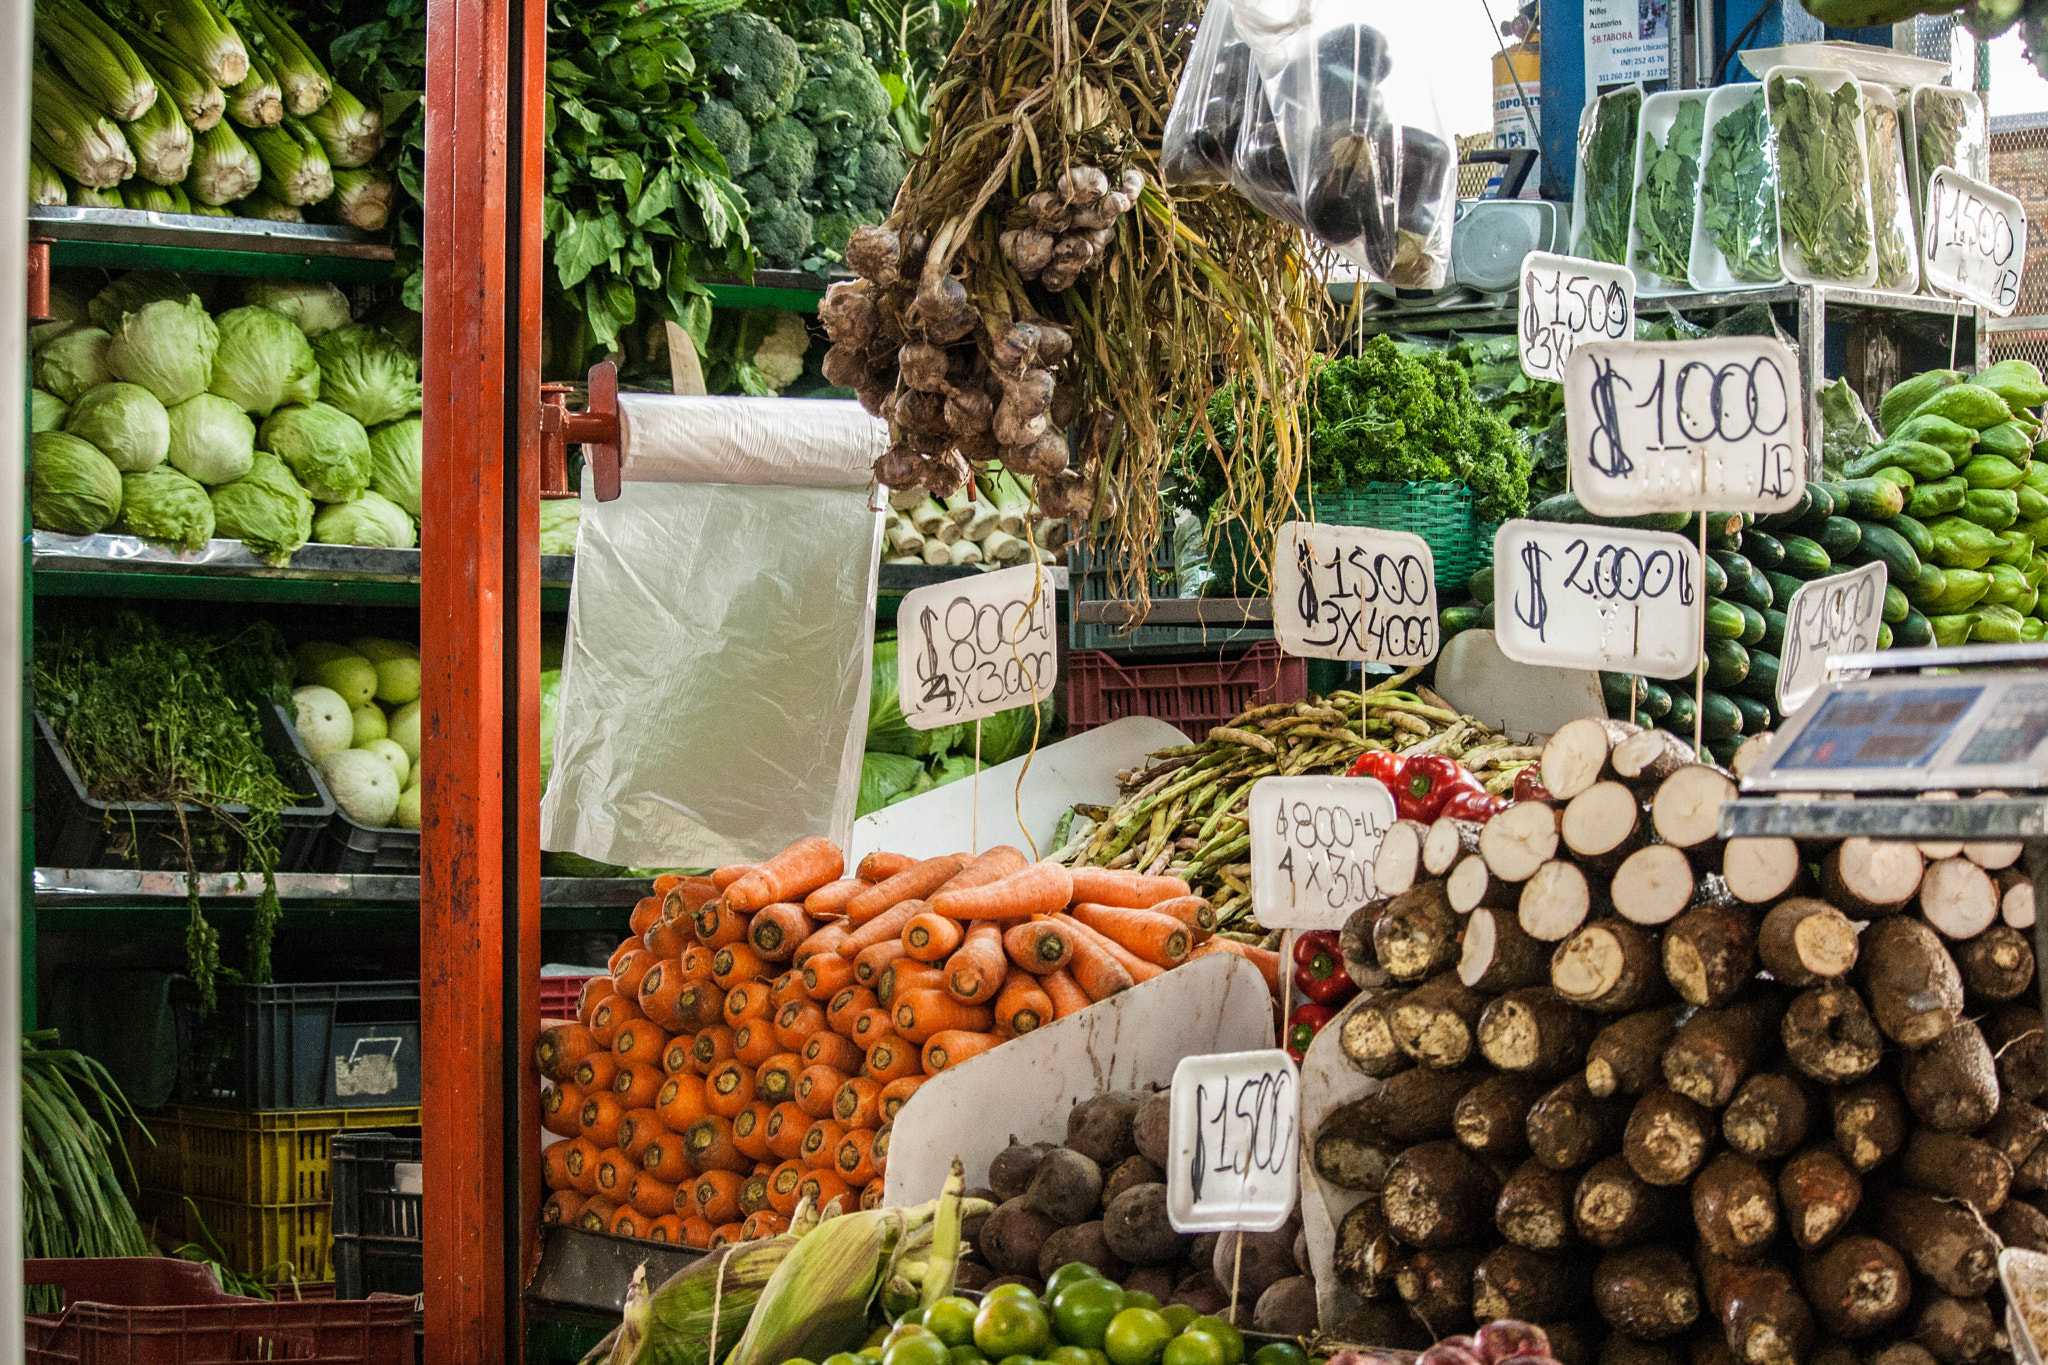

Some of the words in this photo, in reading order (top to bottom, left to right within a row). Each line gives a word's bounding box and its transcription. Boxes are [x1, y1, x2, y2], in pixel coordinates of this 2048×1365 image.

[1589, 19, 1622, 29] Accesorios
[1612, 46, 1641, 54] Excelente
[1634, 56, 1646, 65] 252
[1647, 55, 1656, 64] 45
[1656, 54, 1665, 63] 76
[1610, 72, 1623, 80] 260
